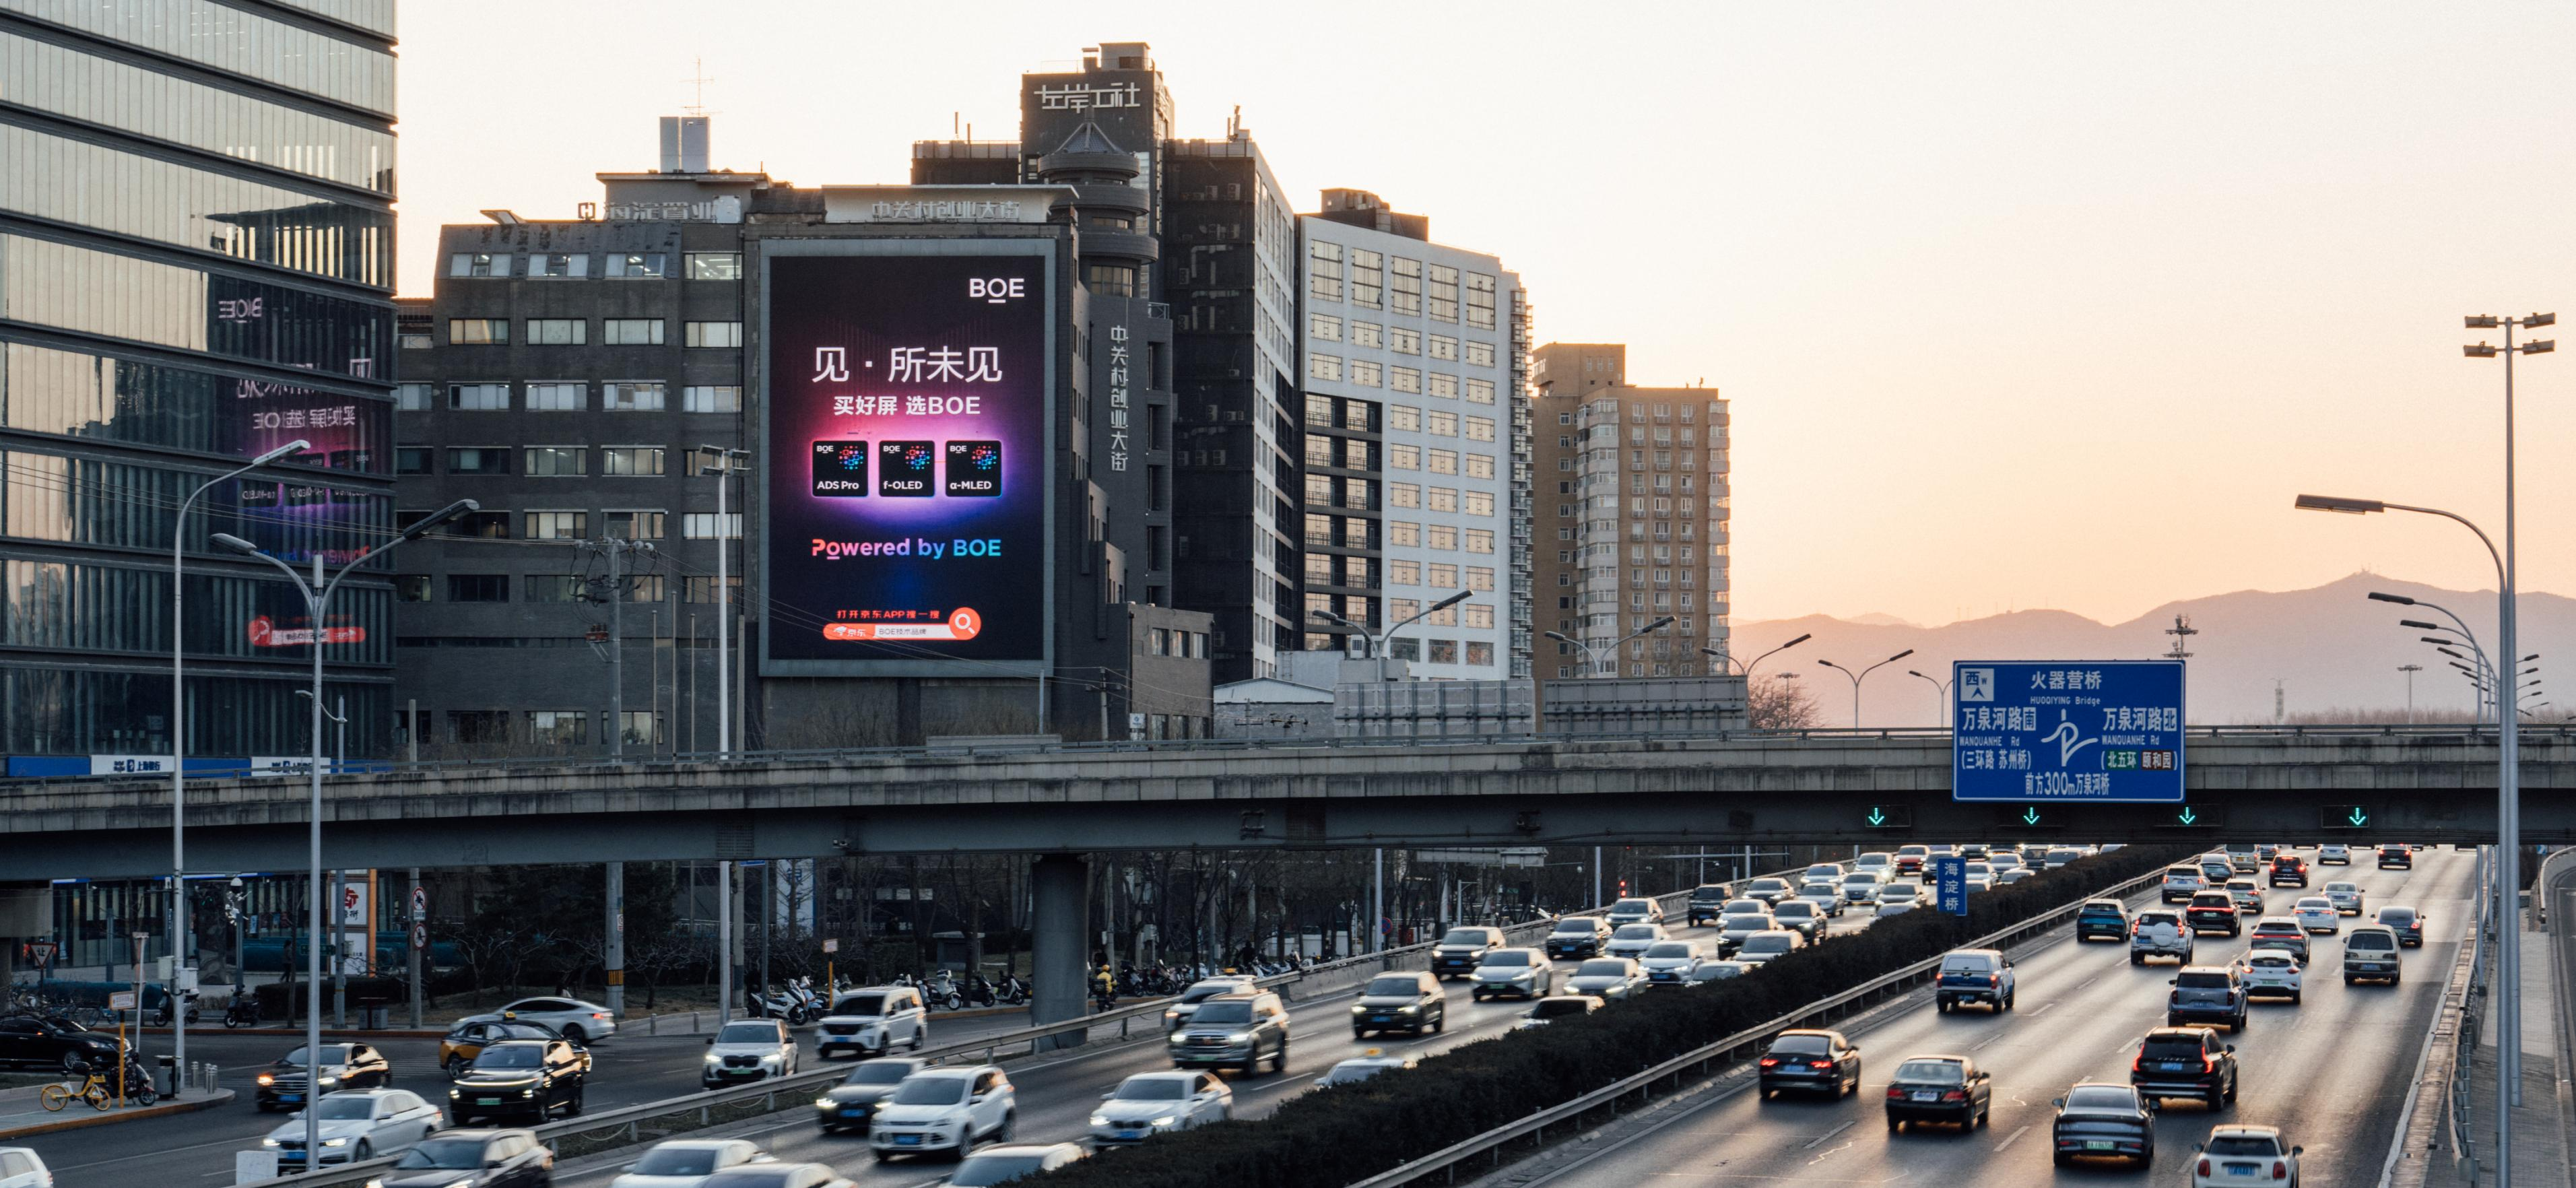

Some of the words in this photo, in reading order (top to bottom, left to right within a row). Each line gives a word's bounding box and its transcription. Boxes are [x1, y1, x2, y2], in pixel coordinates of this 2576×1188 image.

[872, 201, 1020, 219] 中关村创业大街
[969, 278, 1025, 302] BOE
[1111, 328, 1127, 471] 中关村创业大街
[834, 396, 898, 416] 买好屏
[906, 396, 980, 416] 选BOE
[817, 445, 834, 453] BOE
[883, 445, 900, 453] BOE
[950, 445, 967, 453] BOE
[817, 481, 839, 490] ADS
[841, 481, 859, 490] Pro
[883, 481, 923, 490] f-OLED
[812, 539, 910, 560] Powered
[919, 539, 945, 560] by
[954, 539, 1001, 556] BOE
[1965, 671, 1980, 686] 西
[1981, 678, 1987, 686] W
[2030, 671, 2102, 690] 火器营桥
[2030, 696, 2071, 704] HUOQIYING
[2076, 696, 2101, 706] Bridge
[1960, 736, 2002, 746] WANQUANHE
[2011, 737, 2020, 746] Rd
[2102, 735, 2146, 745] WANQUANHE
[2151, 735, 2160, 745] Rd
[1944, 863, 1959, 911] 海淀桥
